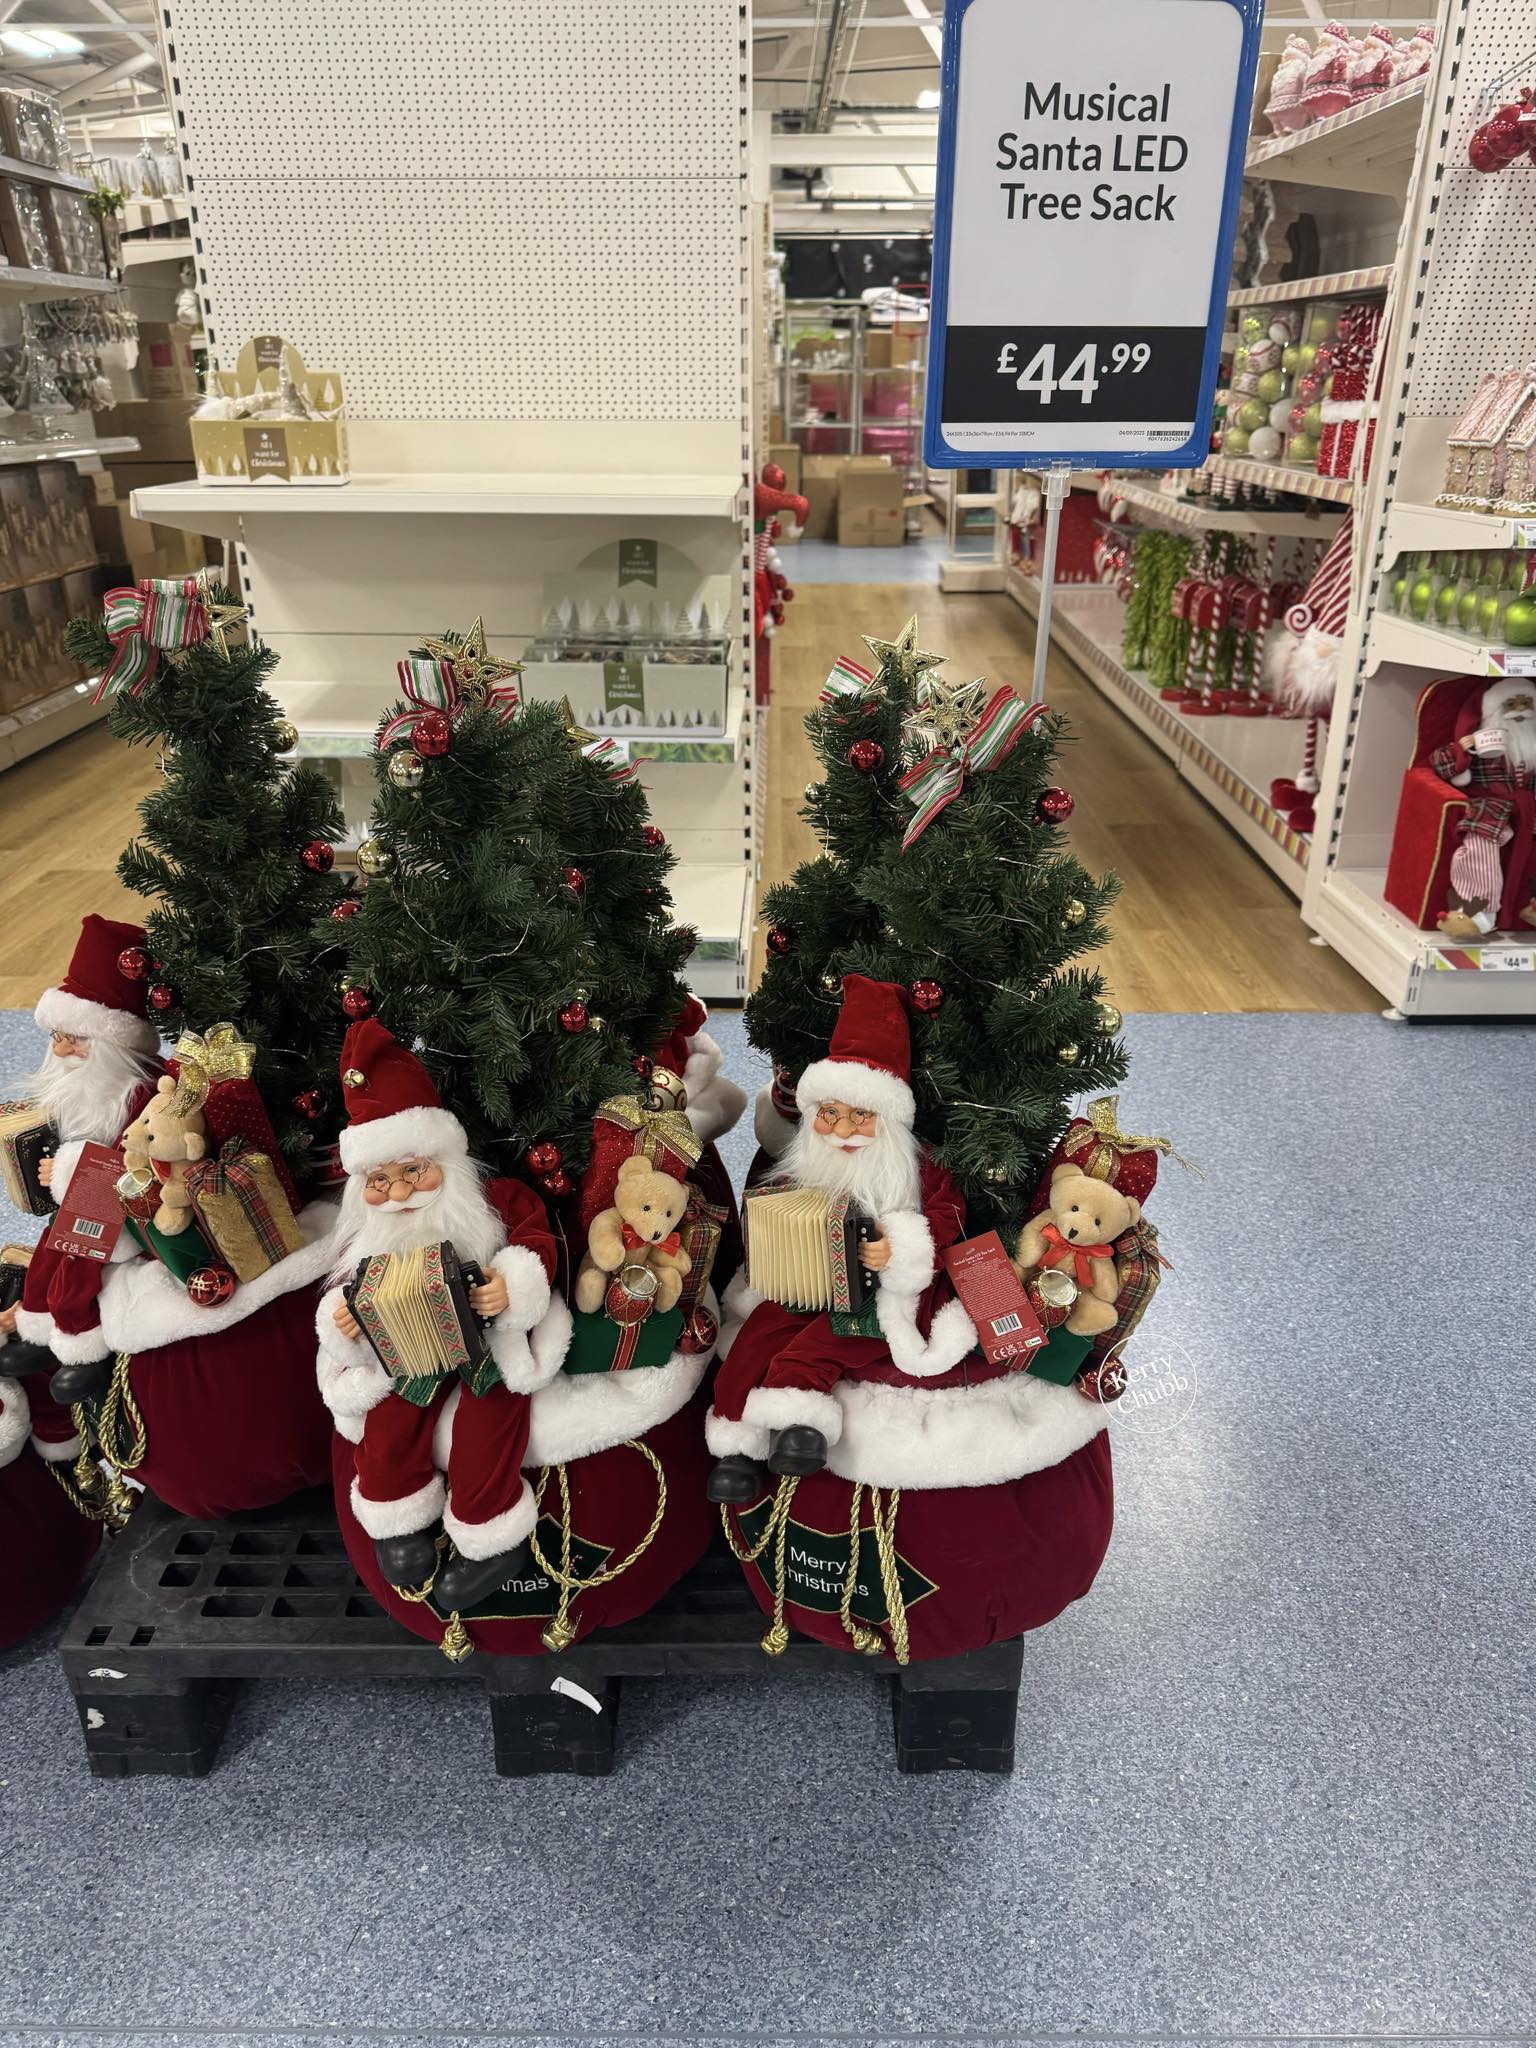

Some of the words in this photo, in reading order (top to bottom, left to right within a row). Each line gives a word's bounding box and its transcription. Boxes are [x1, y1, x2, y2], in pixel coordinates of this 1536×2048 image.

[1024, 81, 1171, 122] Musical
[996, 132, 1102, 171] Santa
[1112, 134, 1188, 172] LED
[1000, 183, 1082, 220] Tree
[1090, 183, 1177, 221] Sack
[997, 342, 1151, 404] £44.99
[790, 1546, 847, 1575] Merry
[784, 1565, 870, 1597] hristms
